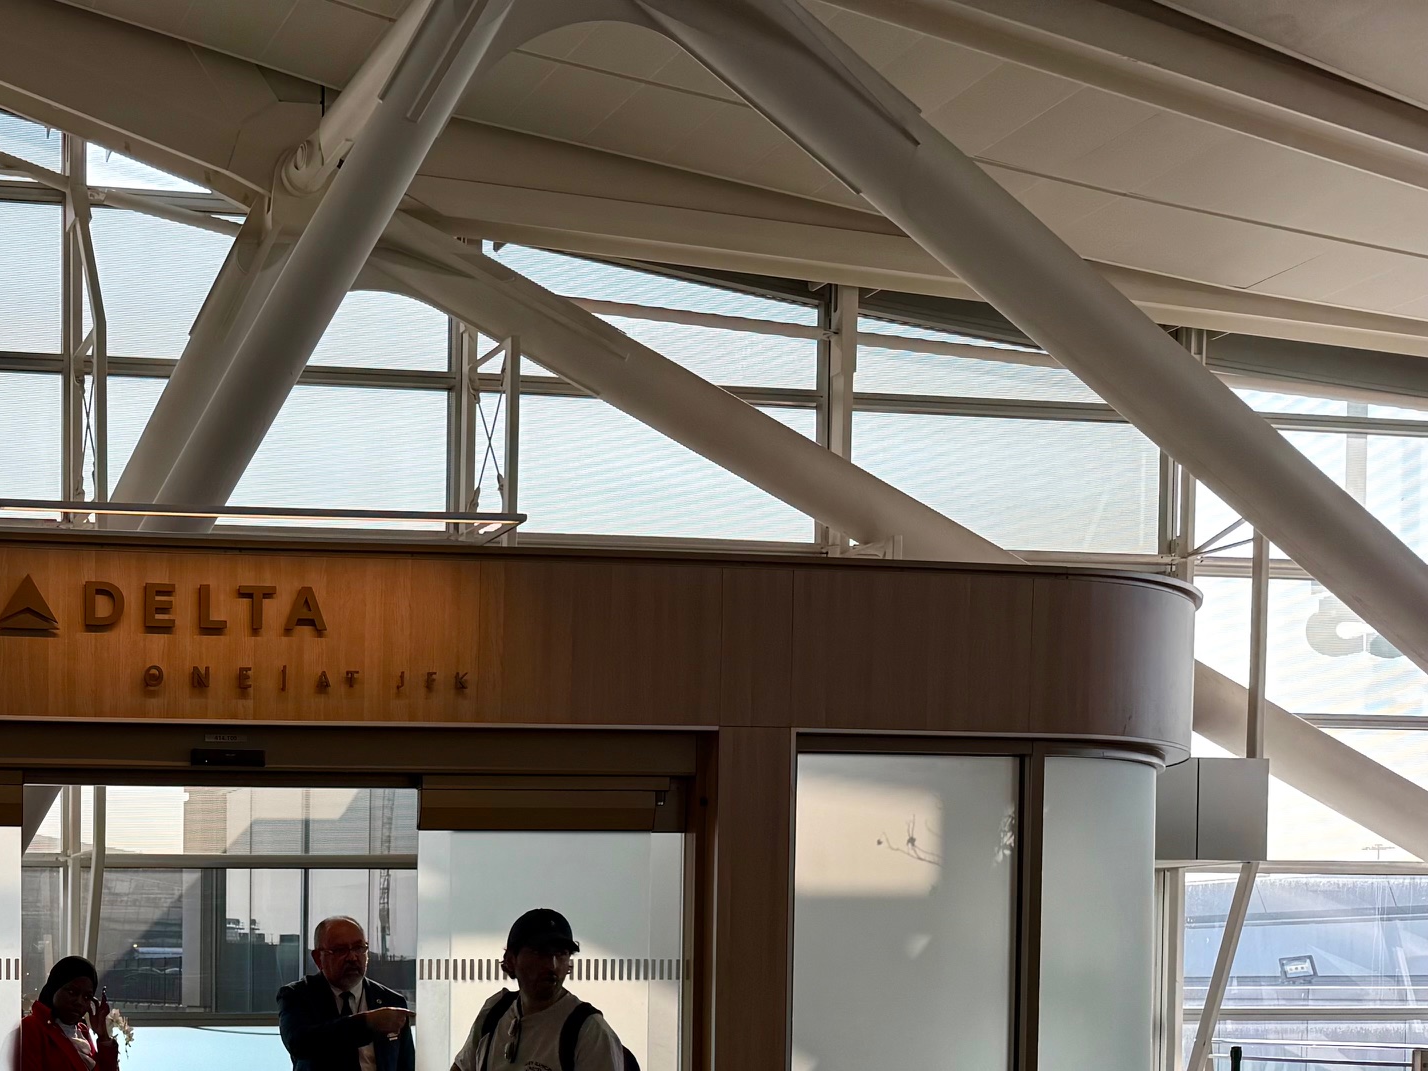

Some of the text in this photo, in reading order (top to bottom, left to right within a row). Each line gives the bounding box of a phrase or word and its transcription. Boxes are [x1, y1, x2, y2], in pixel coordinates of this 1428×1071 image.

[83, 579, 329, 634] DELTA
[143, 664, 253, 689] ONE
[316, 669, 360, 690] AT
[396, 670, 470, 691] JFK
